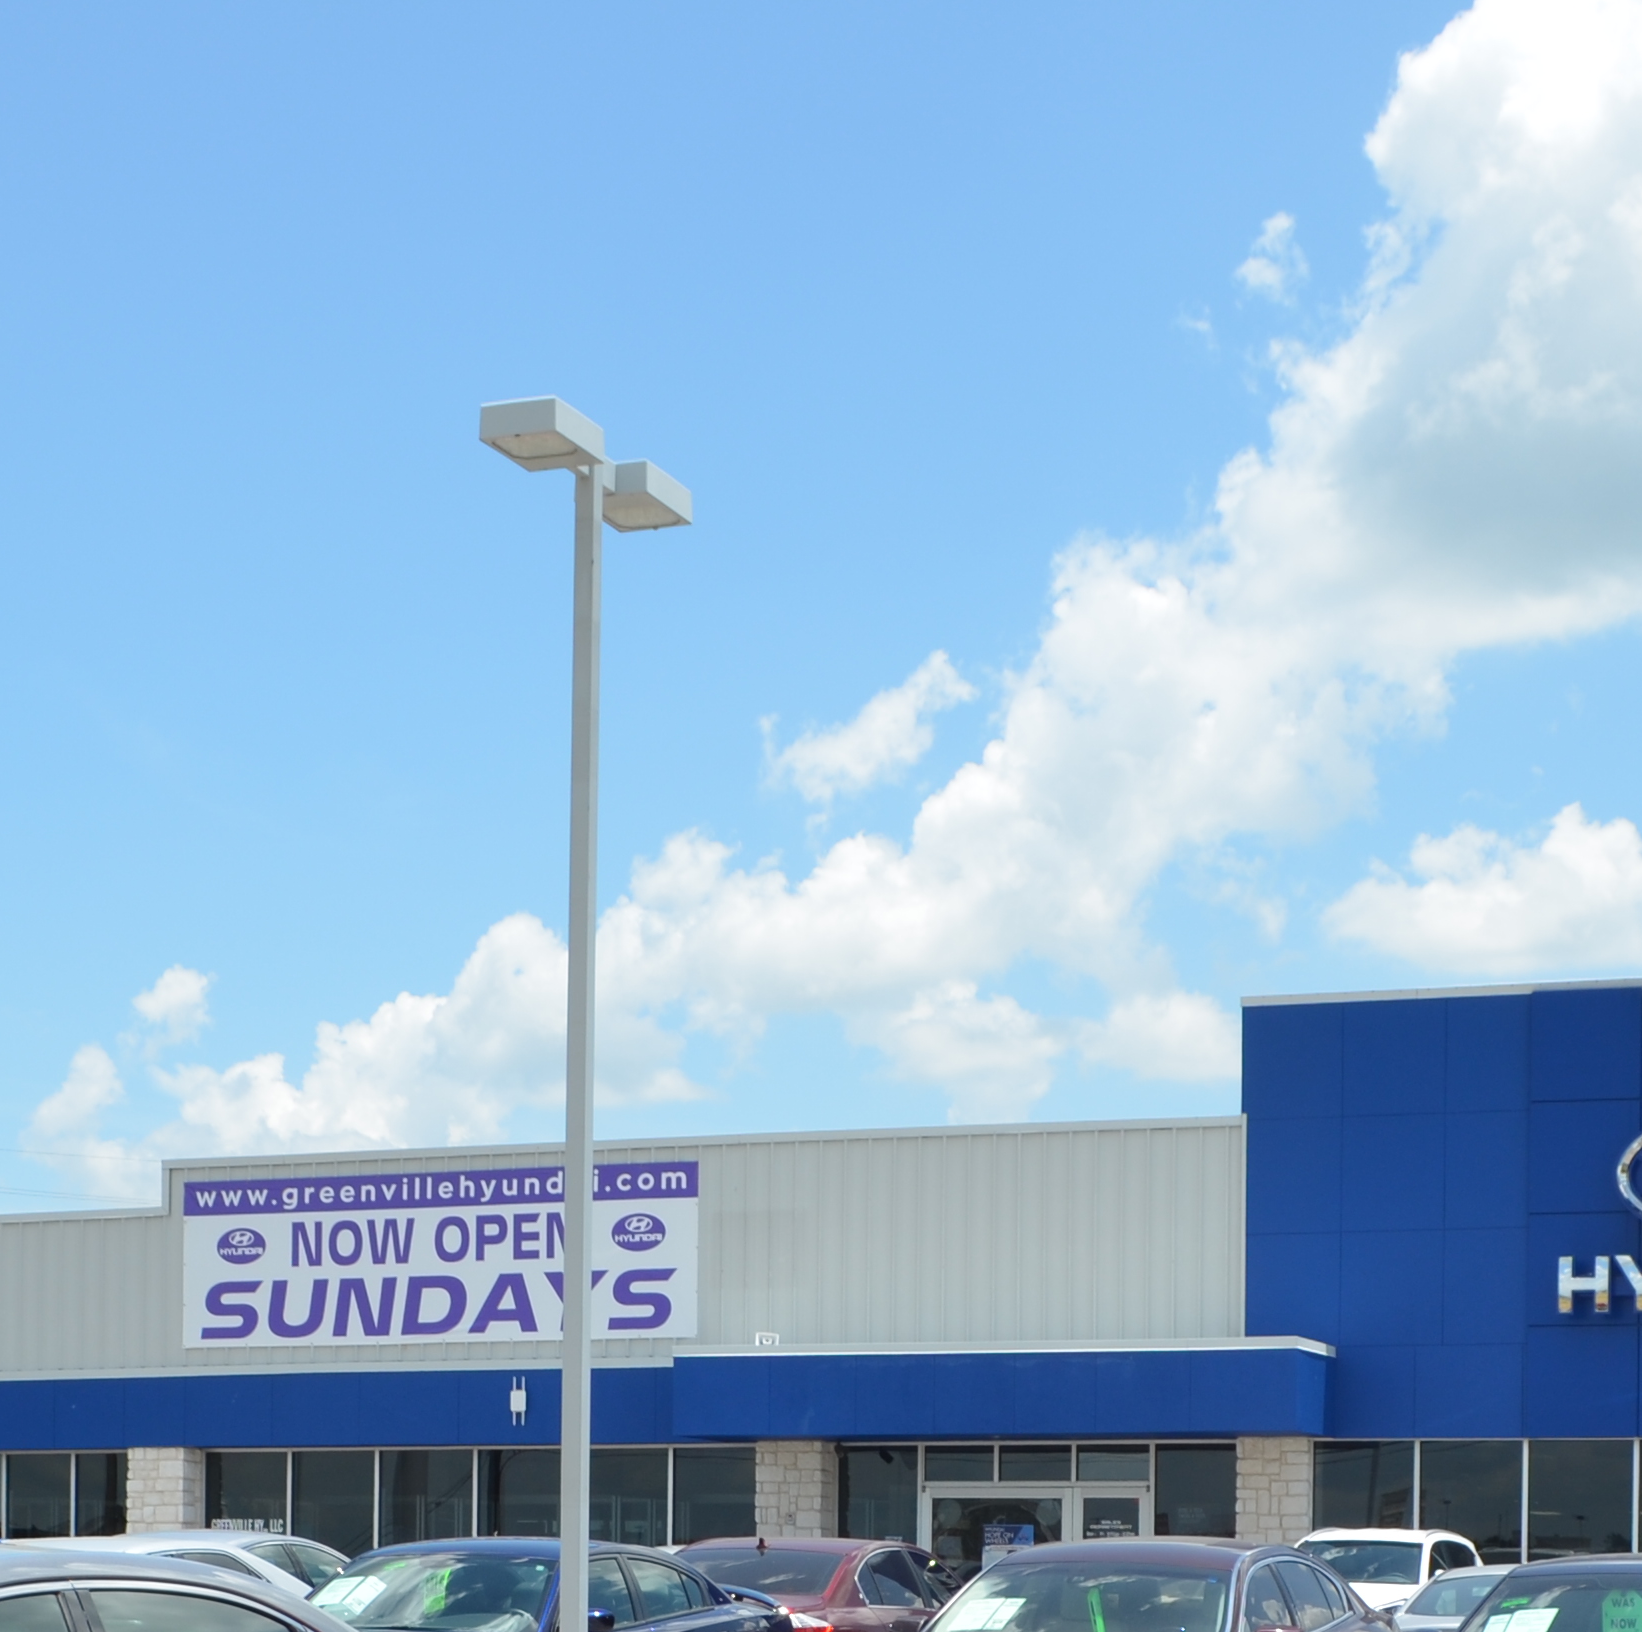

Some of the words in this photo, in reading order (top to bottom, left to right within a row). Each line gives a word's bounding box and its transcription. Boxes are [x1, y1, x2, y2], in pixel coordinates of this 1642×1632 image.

[195, 1169, 688, 1211] www.greenvillehyundi.com
[291, 1217, 415, 1268] NOW
[614, 1233, 663, 1243] HYUNDAI
[219, 1246, 264, 1256] HYUNDAI
[269, 1518, 284, 1533] LLC
[1611, 1598, 1635, 1608] WAS
[1610, 1618, 1637, 1629] NOW
